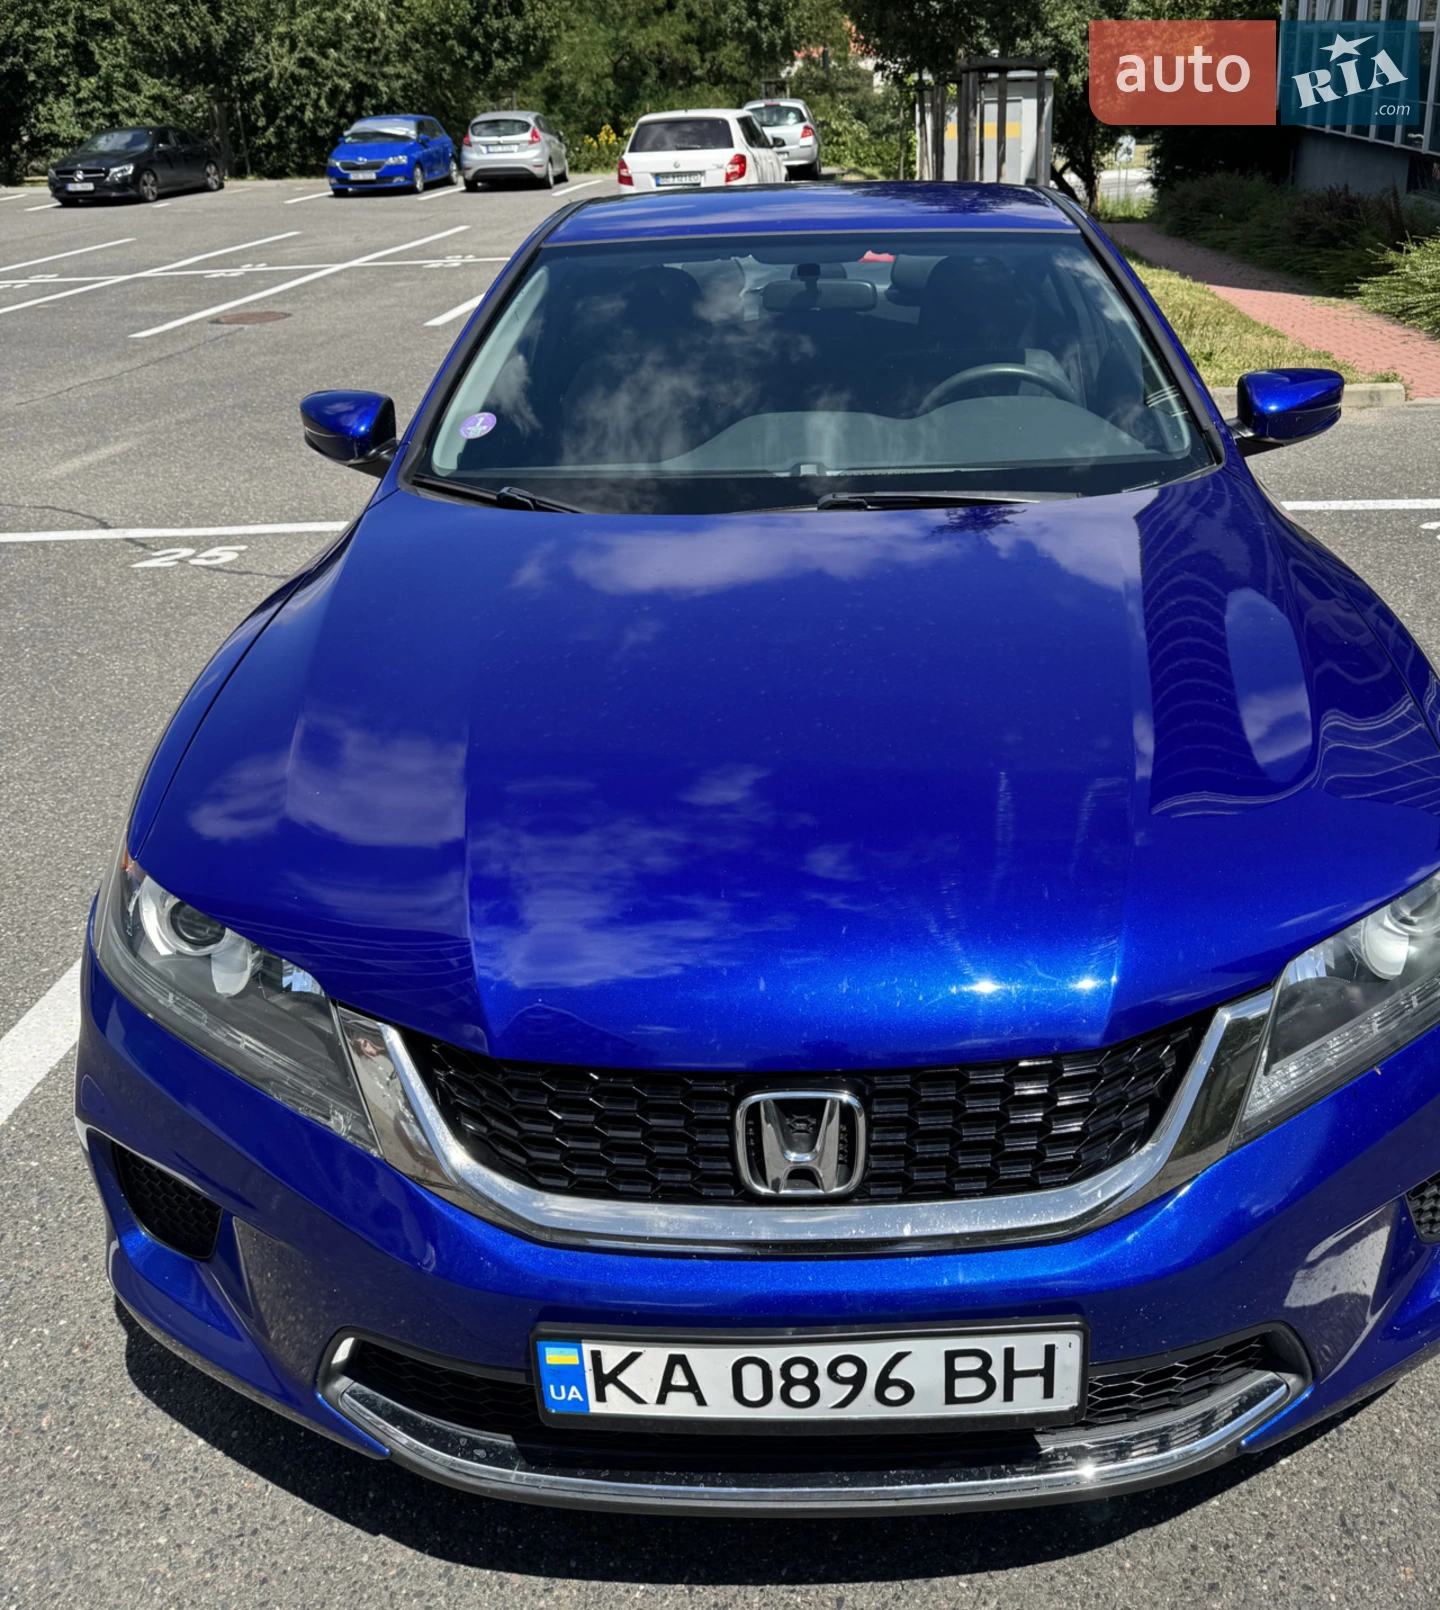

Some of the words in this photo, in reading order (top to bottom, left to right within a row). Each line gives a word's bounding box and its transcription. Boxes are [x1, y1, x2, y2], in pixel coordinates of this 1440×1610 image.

[130, 545, 249, 568] 25
[590, 1349, 709, 1407] KA
[731, 1350, 916, 1410] 0896
[944, 1343, 1056, 1406] BH
[549, 1384, 584, 1402] UA
